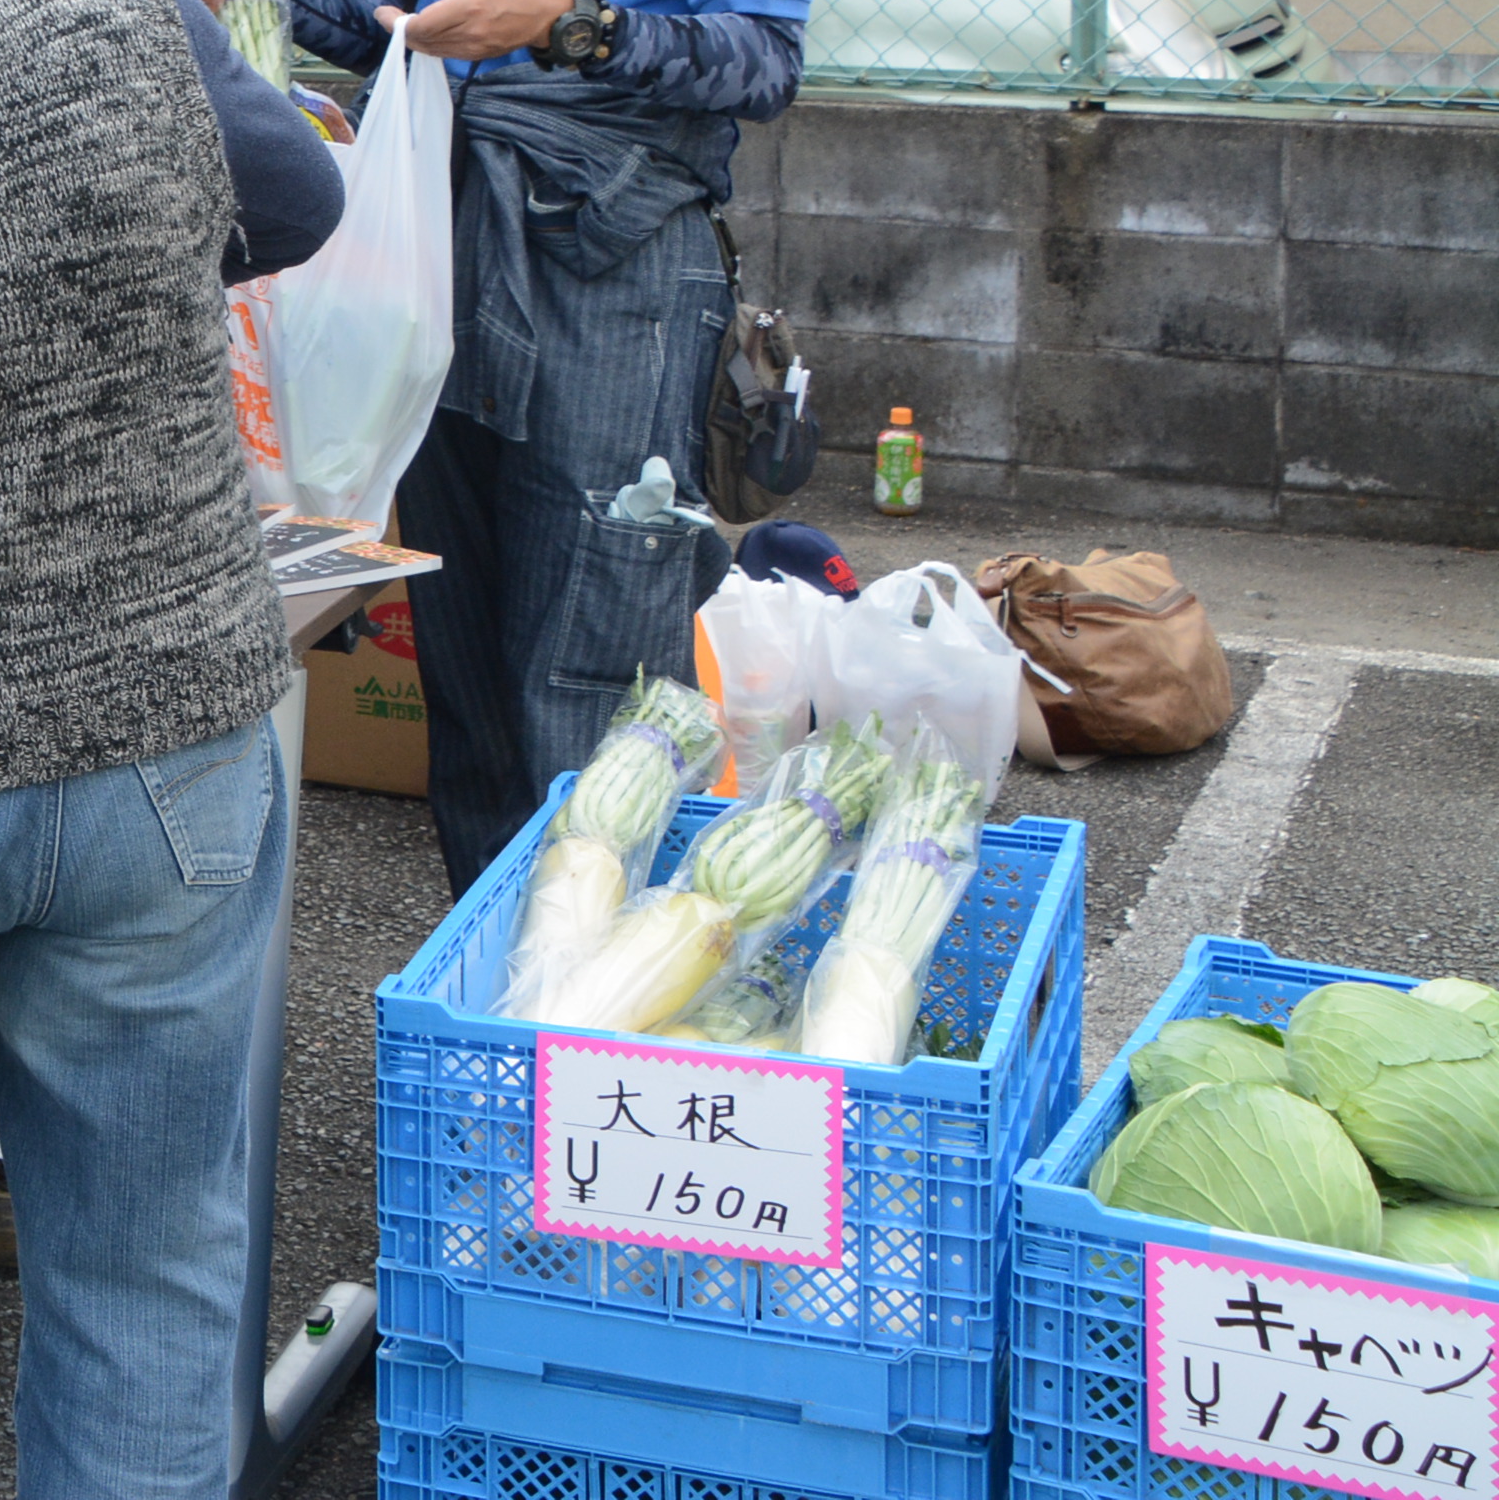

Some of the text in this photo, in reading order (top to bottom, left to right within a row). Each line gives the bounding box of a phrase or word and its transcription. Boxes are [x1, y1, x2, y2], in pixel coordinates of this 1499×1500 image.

[596, 1079, 761, 1150] 大根
[1214, 1280, 1494, 1395] キャベツ
